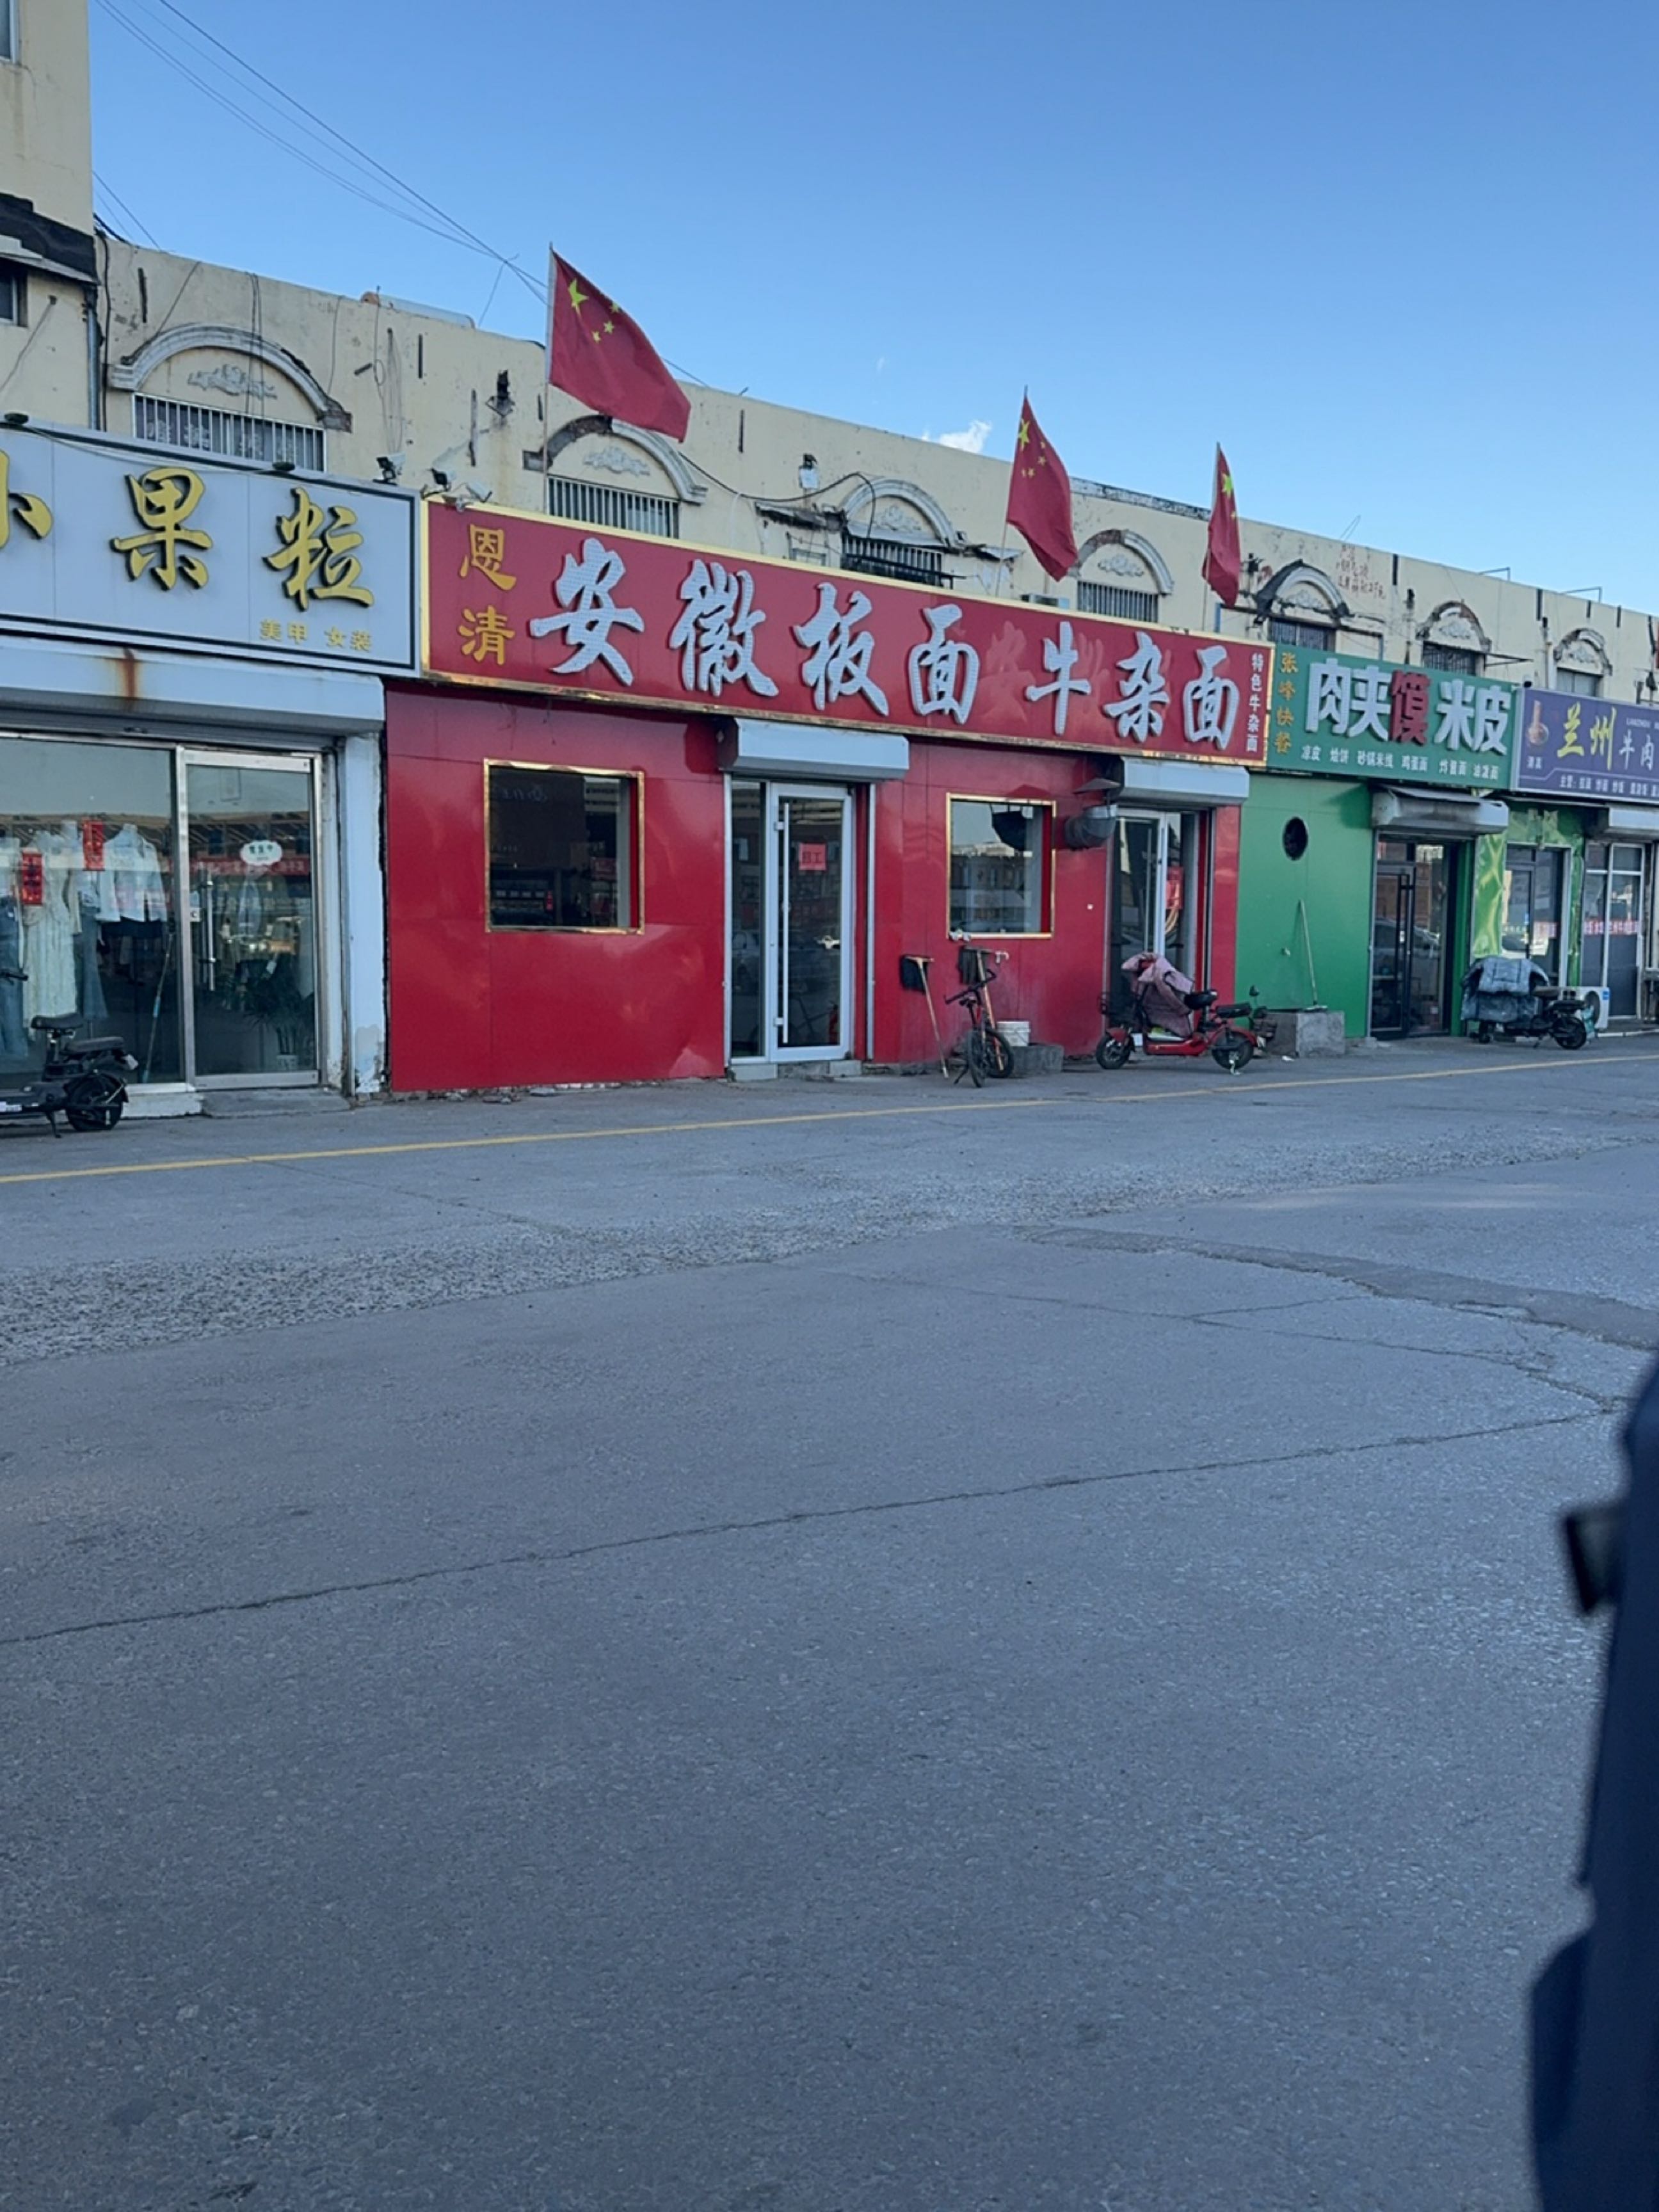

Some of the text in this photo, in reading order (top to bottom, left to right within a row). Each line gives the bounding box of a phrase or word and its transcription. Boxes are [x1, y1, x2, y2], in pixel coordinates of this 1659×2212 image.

[259, 619, 371, 652] 美甲 女装
[459, 524, 516, 665] 恩清
[529, 537, 981, 725] 安徽板面
[1246, 652, 1264, 752] 特色牛杂面
